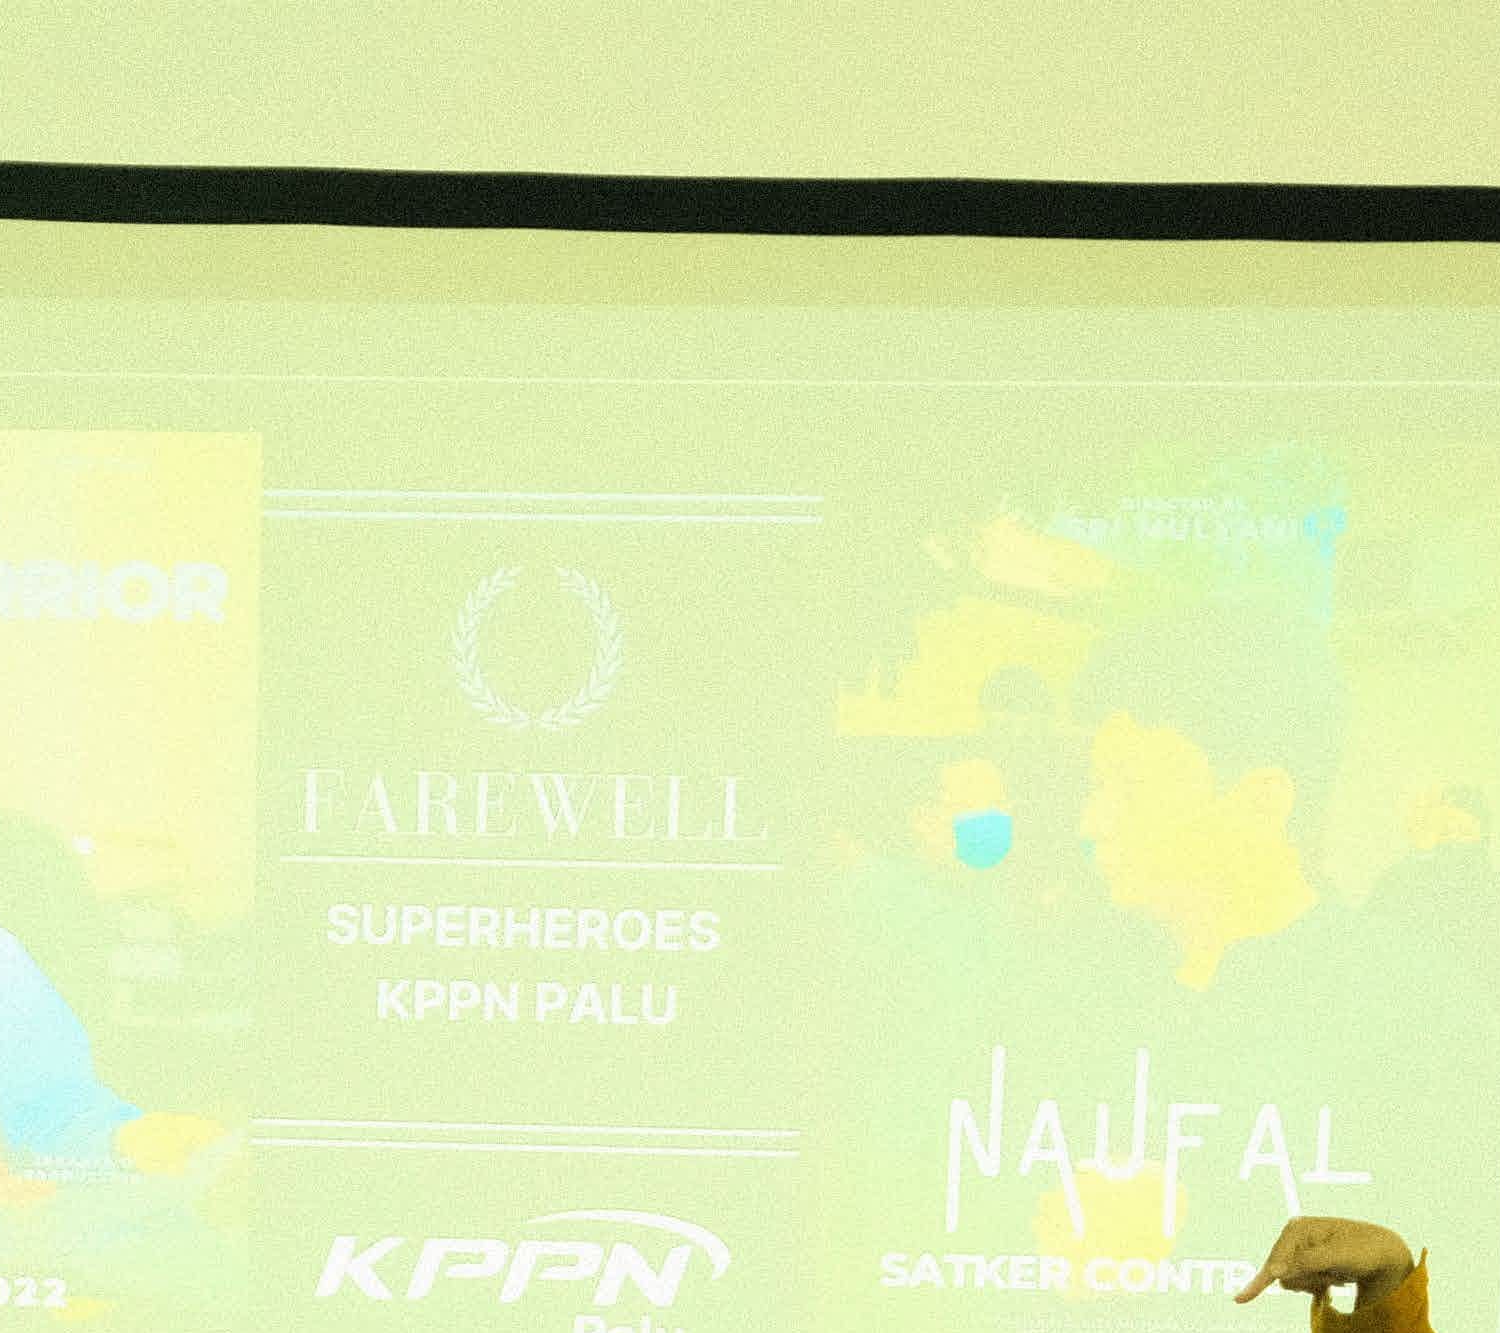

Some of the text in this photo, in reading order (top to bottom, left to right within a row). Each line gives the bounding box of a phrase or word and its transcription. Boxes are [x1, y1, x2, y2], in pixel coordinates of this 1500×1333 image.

[301, 767, 769, 842] FAREWELL
[326, 903, 722, 952] SUPERHEROES
[376, 978, 678, 1026] KPPN PALU
[945, 1045, 1372, 1239] NAUFAL
[313, 1234, 693, 1307] KPPN
[879, 1250, 1283, 1295] SATKER CONTR
